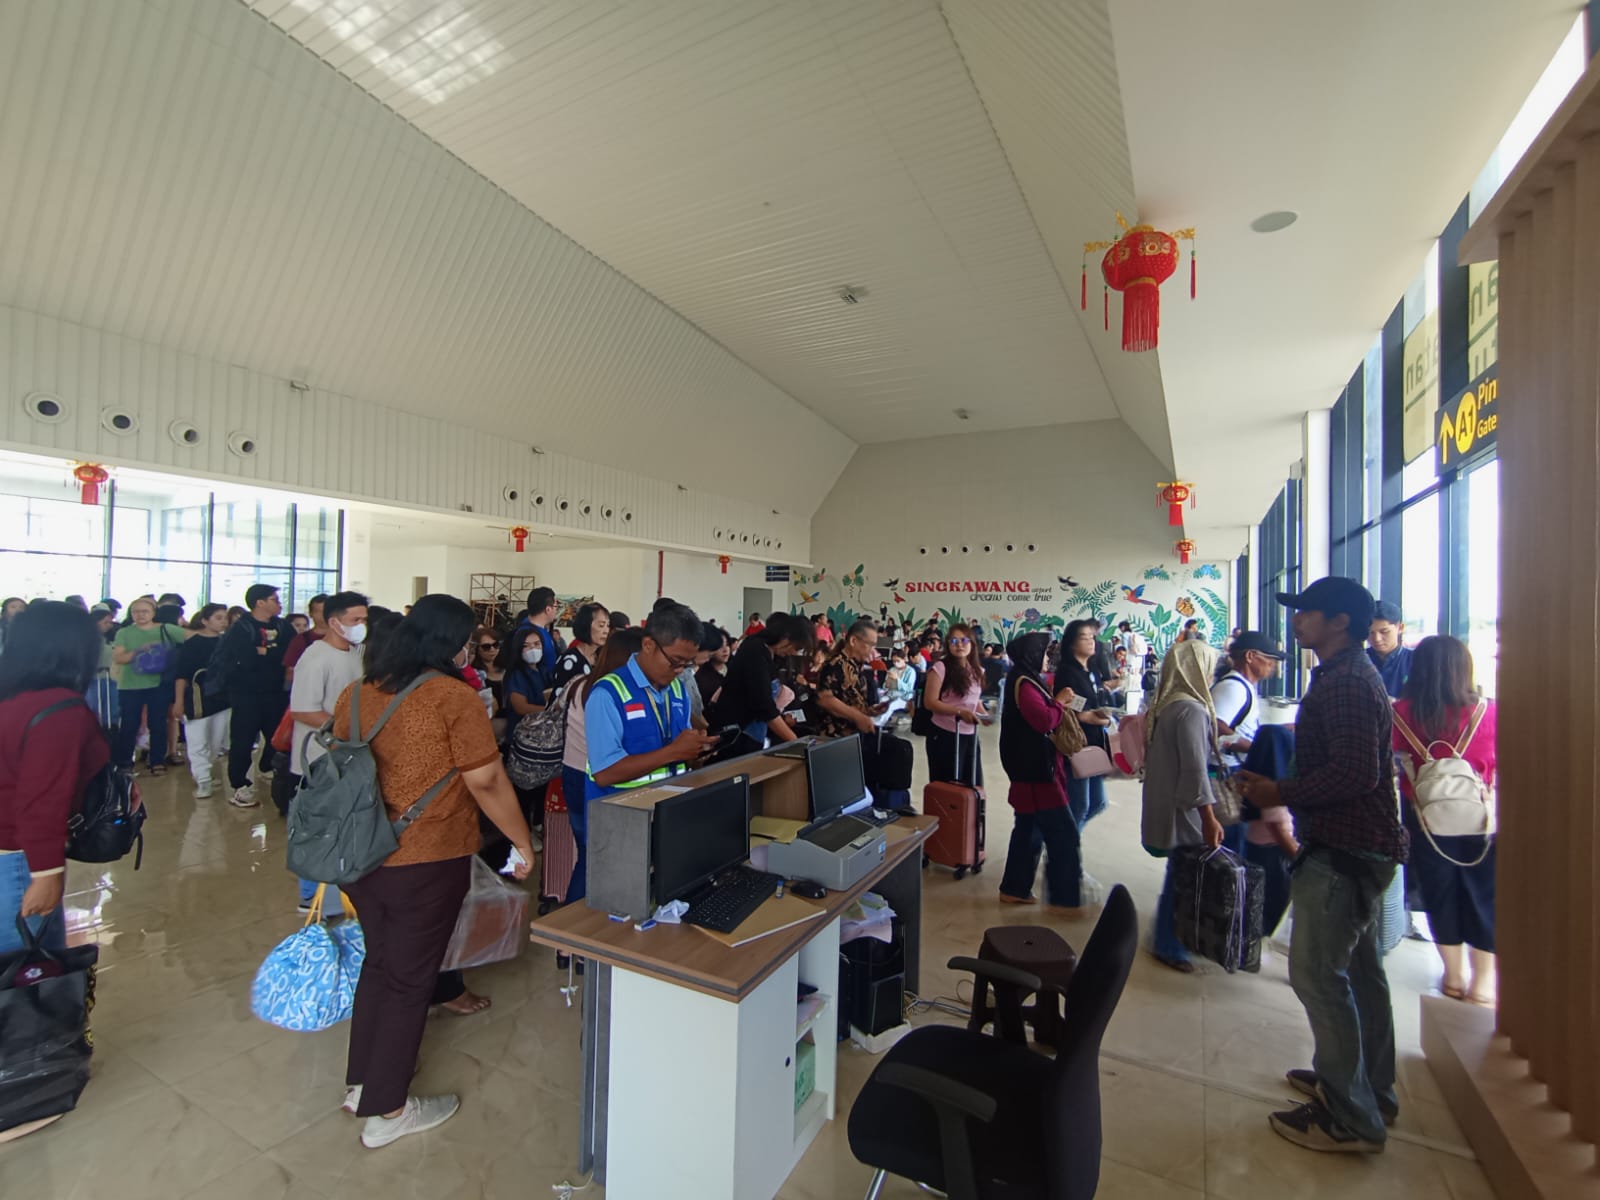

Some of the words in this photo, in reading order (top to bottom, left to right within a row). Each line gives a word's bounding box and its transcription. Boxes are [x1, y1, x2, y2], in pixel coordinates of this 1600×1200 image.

[1478, 377, 1497, 410] Pin
[1458, 404, 1474, 442] A1
[1477, 414, 1497, 439] Gate
[905, 581, 1030, 593] SINGKAWANG
[1006, 594, 1031, 602] come
[1033, 593, 1053, 602] true
